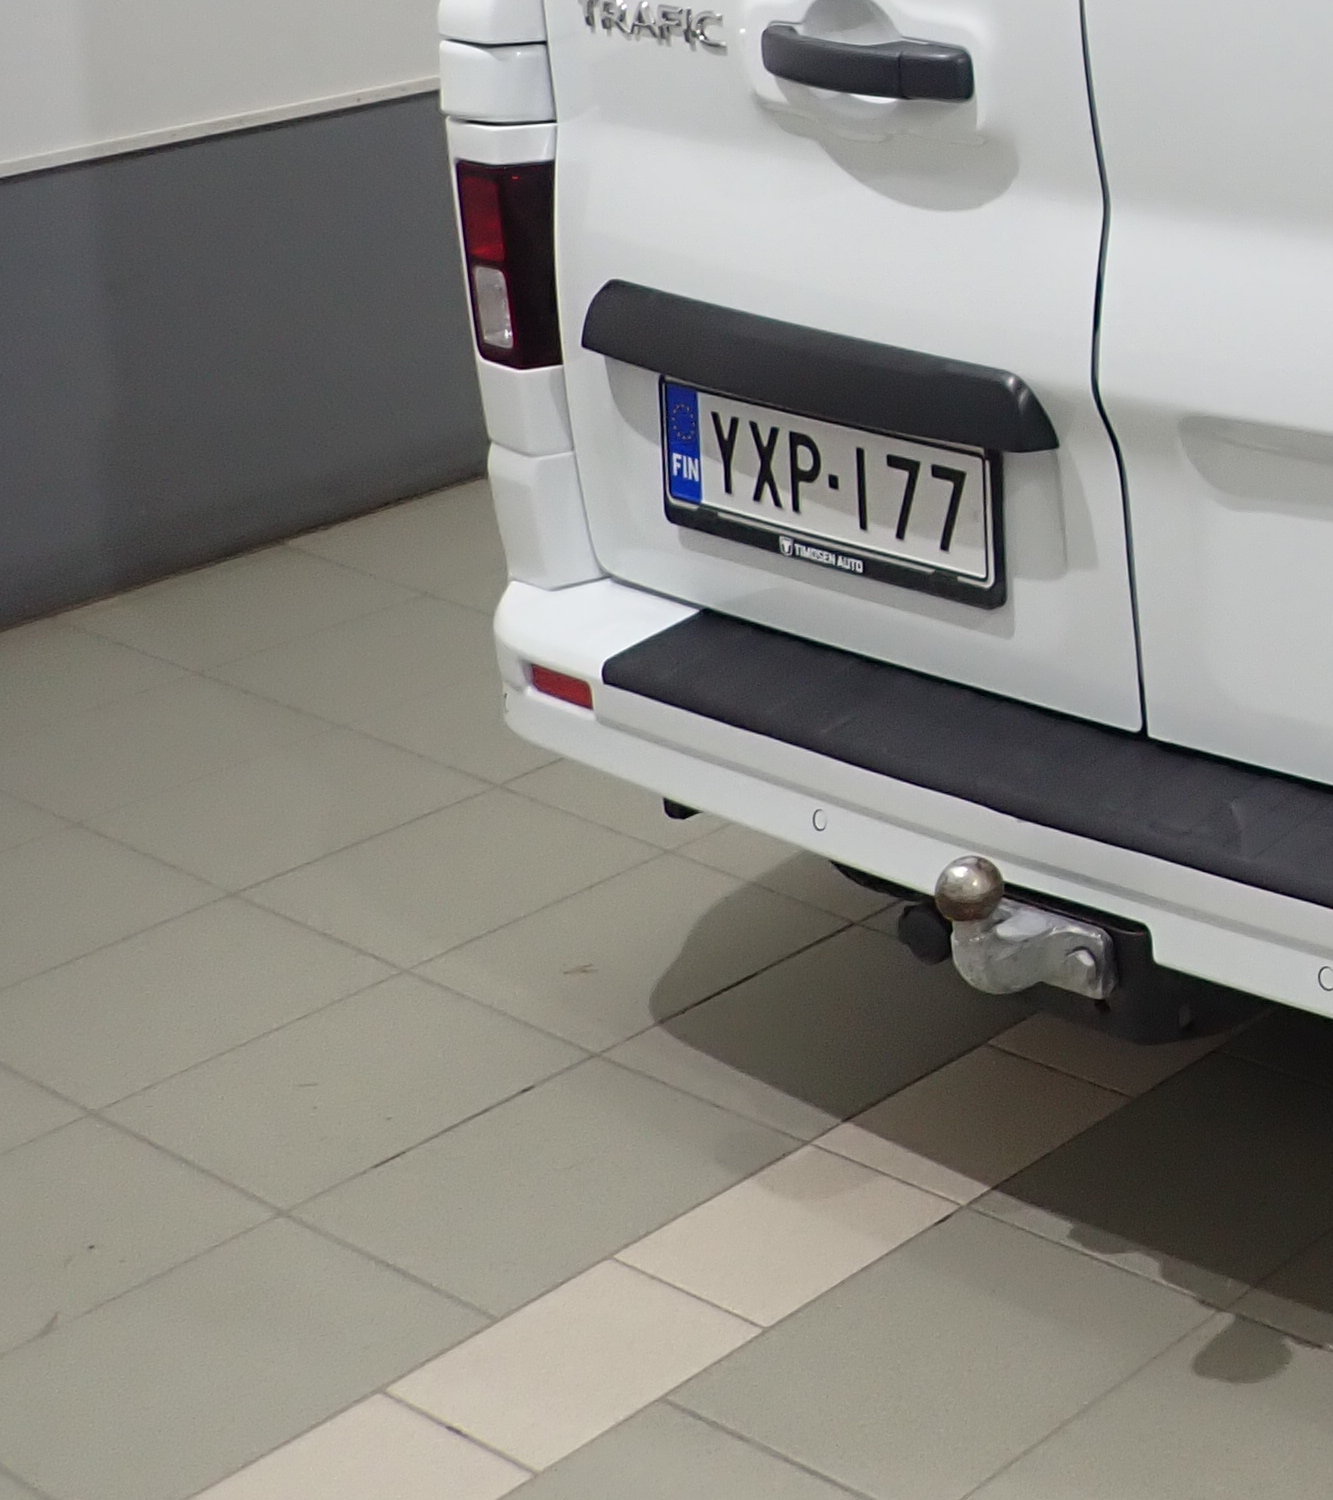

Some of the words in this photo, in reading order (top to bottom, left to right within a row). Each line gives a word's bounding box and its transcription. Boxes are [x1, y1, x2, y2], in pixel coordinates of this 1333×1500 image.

[672, 453, 699, 482] FIN
[711, 411, 966, 553] YXP-177
[794, 543, 836, 566] TIMOSEN
[837, 555, 864, 573] AUTO
